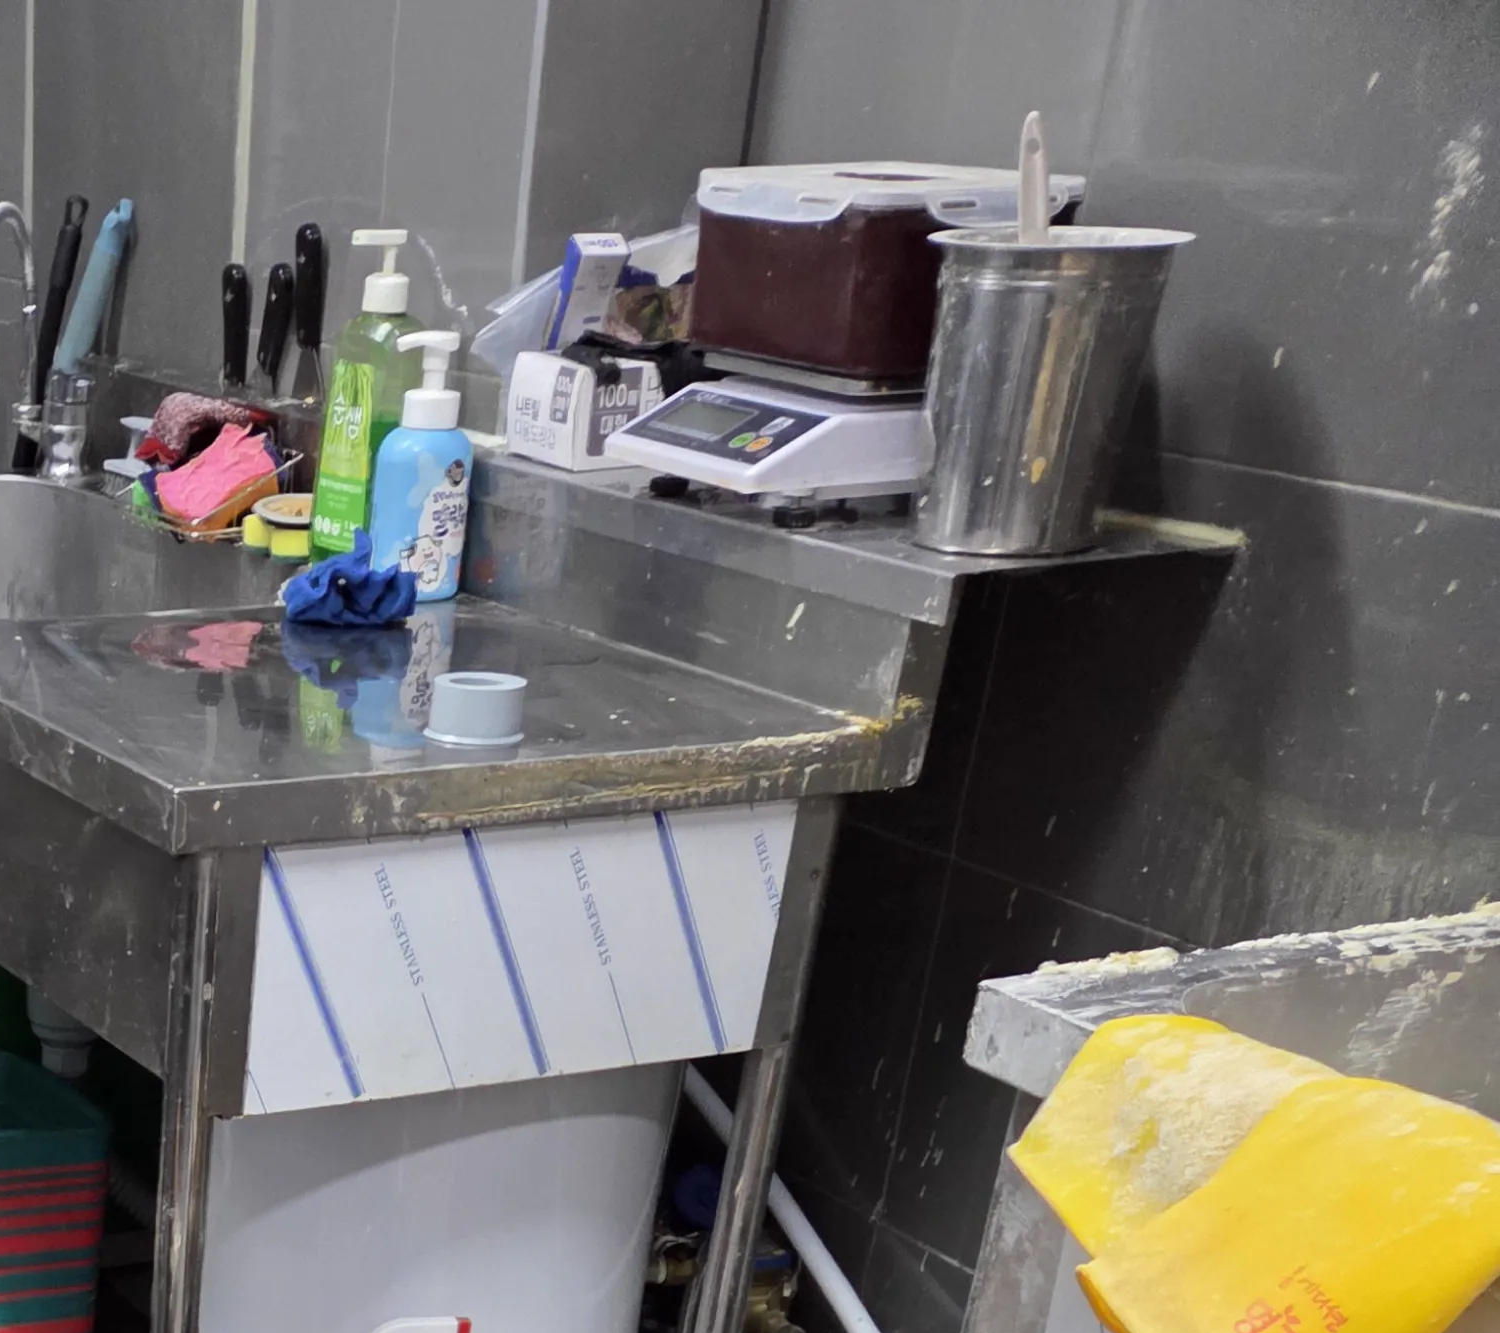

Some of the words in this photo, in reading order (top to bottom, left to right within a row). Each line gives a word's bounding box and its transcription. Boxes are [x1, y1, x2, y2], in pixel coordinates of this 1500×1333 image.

[374, 861, 397, 910] STEEL
[569, 846, 591, 892] STEEL
[390, 911, 425, 987] STAINLESS
[583, 893, 612, 967] STAINLESS
